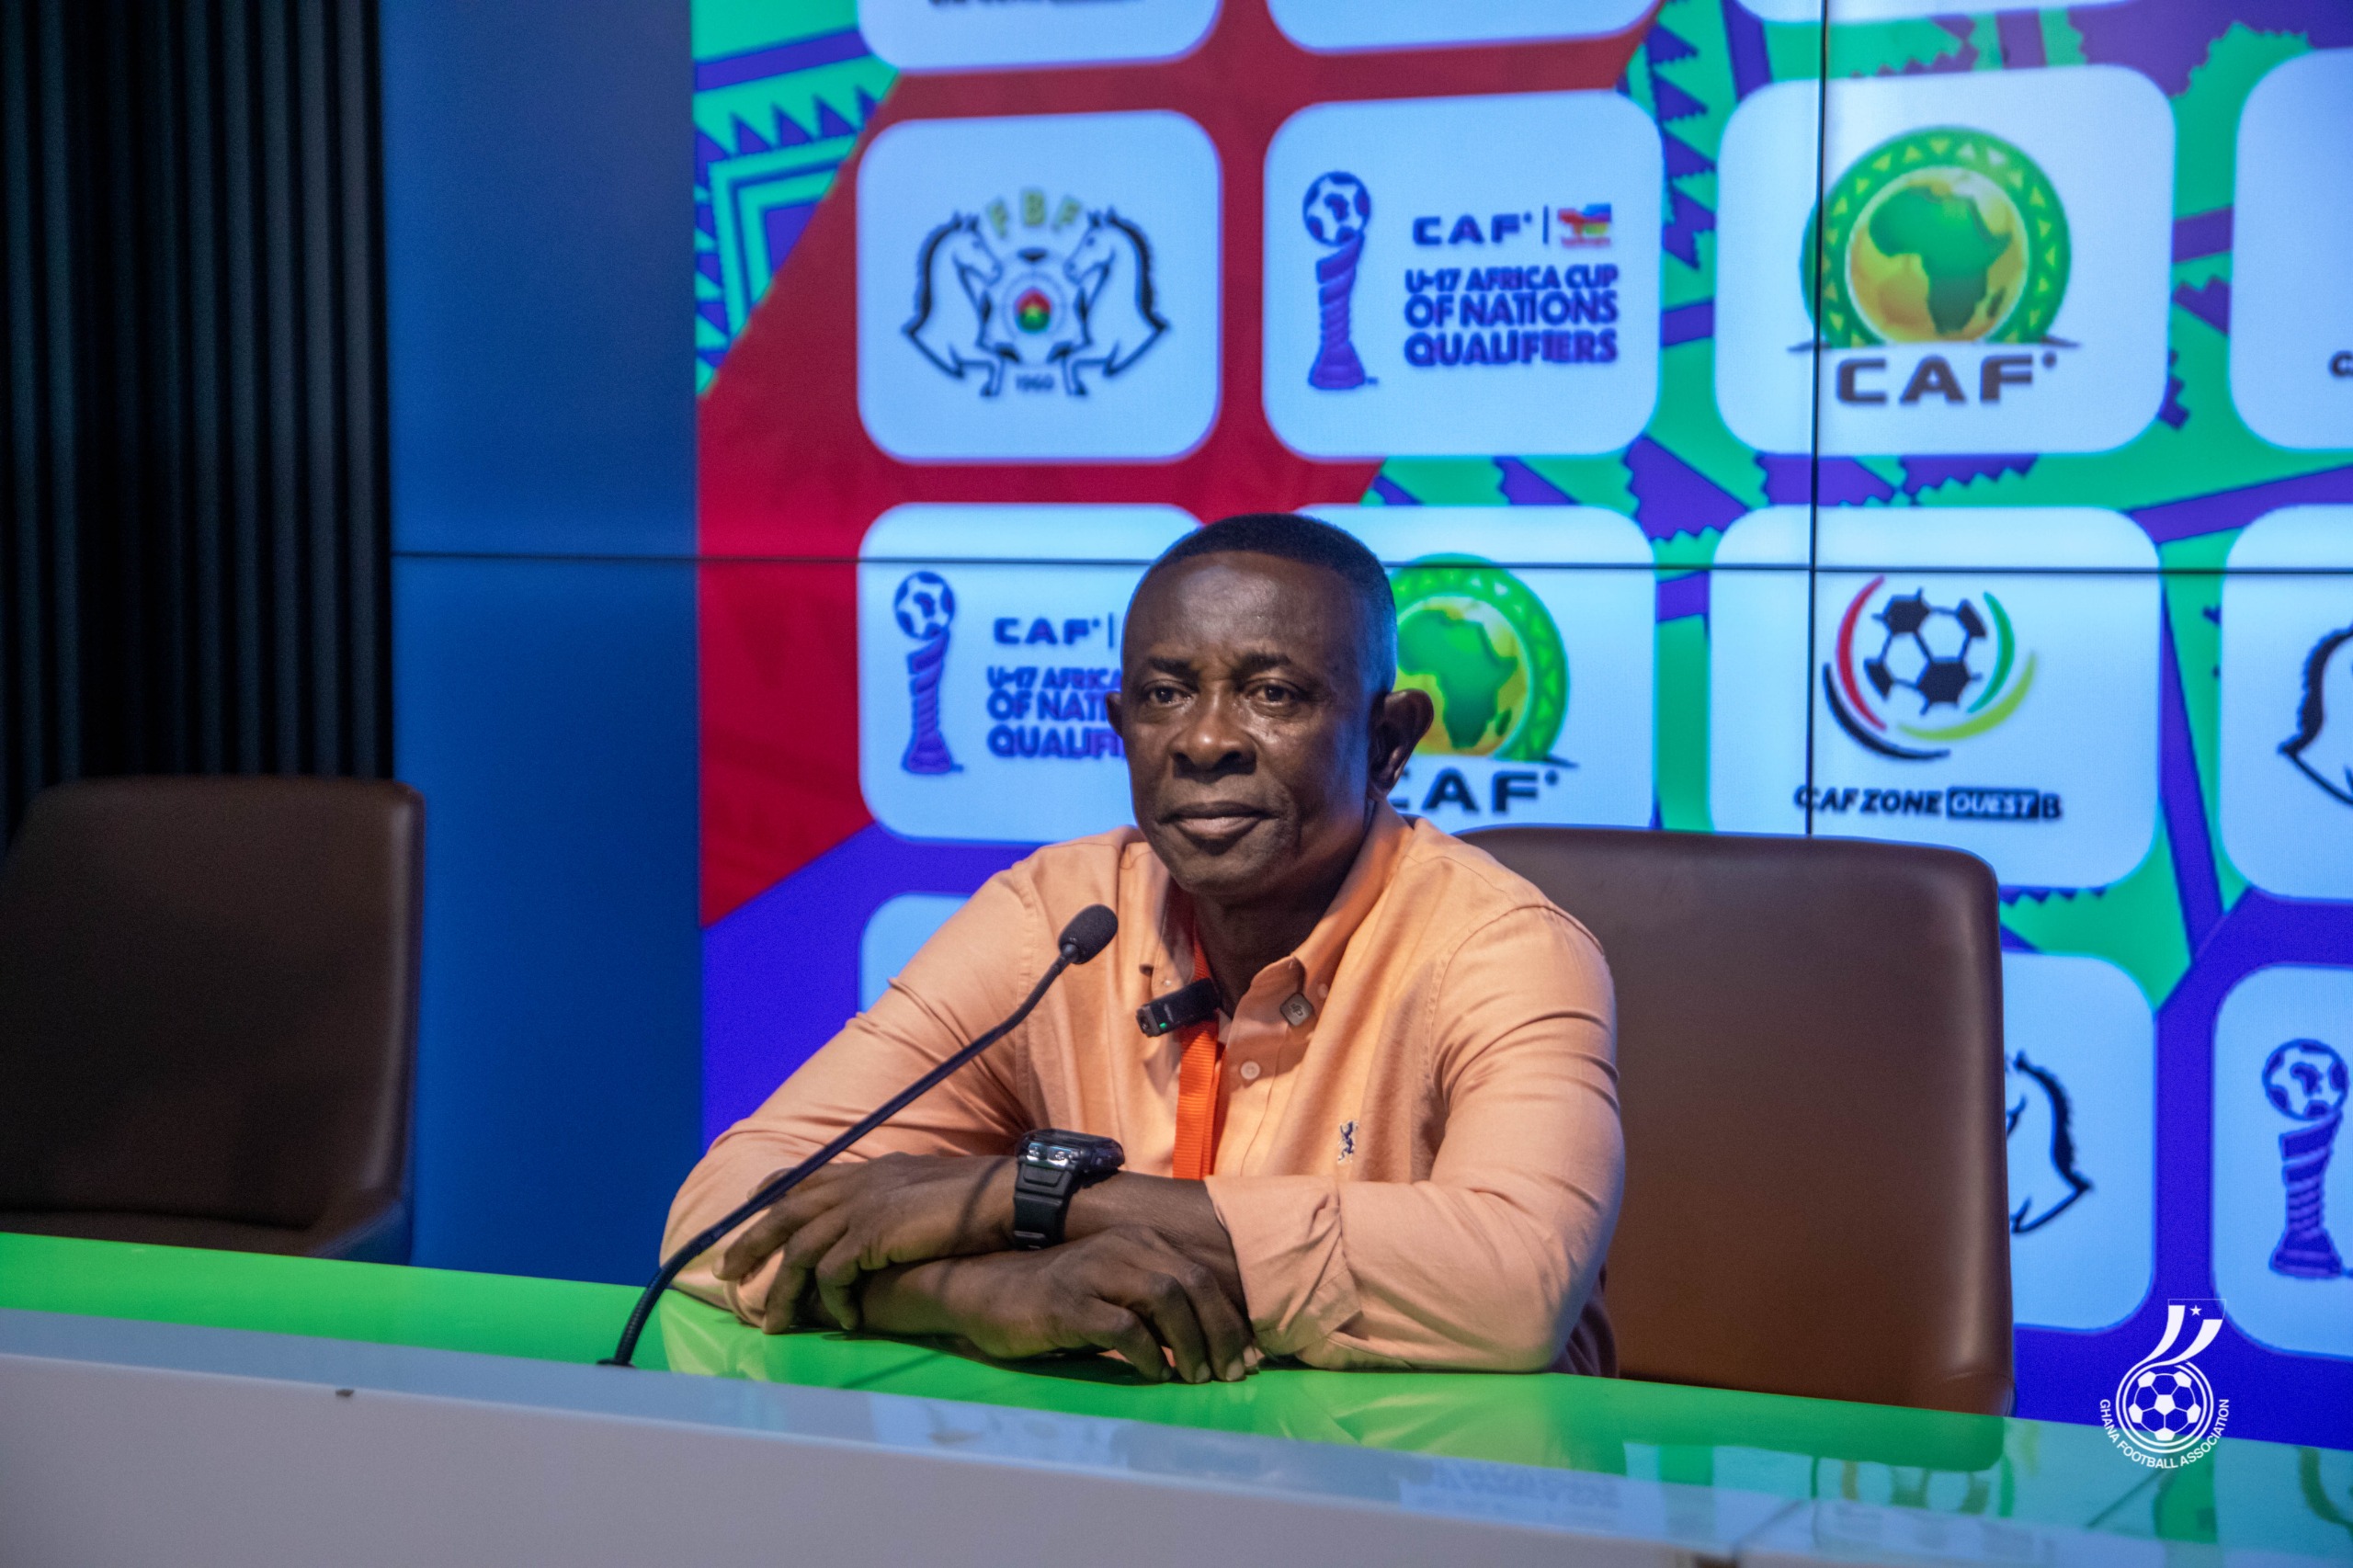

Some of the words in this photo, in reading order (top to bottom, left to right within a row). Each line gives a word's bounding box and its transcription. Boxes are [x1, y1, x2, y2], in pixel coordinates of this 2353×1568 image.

[1404, 267, 1461, 293] U-17
[1465, 265, 1561, 291] AFRICA
[1564, 264, 1619, 290] CUP
[1404, 293, 1454, 328] OF
[1460, 290, 1619, 327] NATIONS
[1404, 328, 1619, 368] QUALIFIERS
[986, 665, 1039, 690] U-17
[986, 688, 1032, 721] OF
[2041, 793, 2063, 820] B
